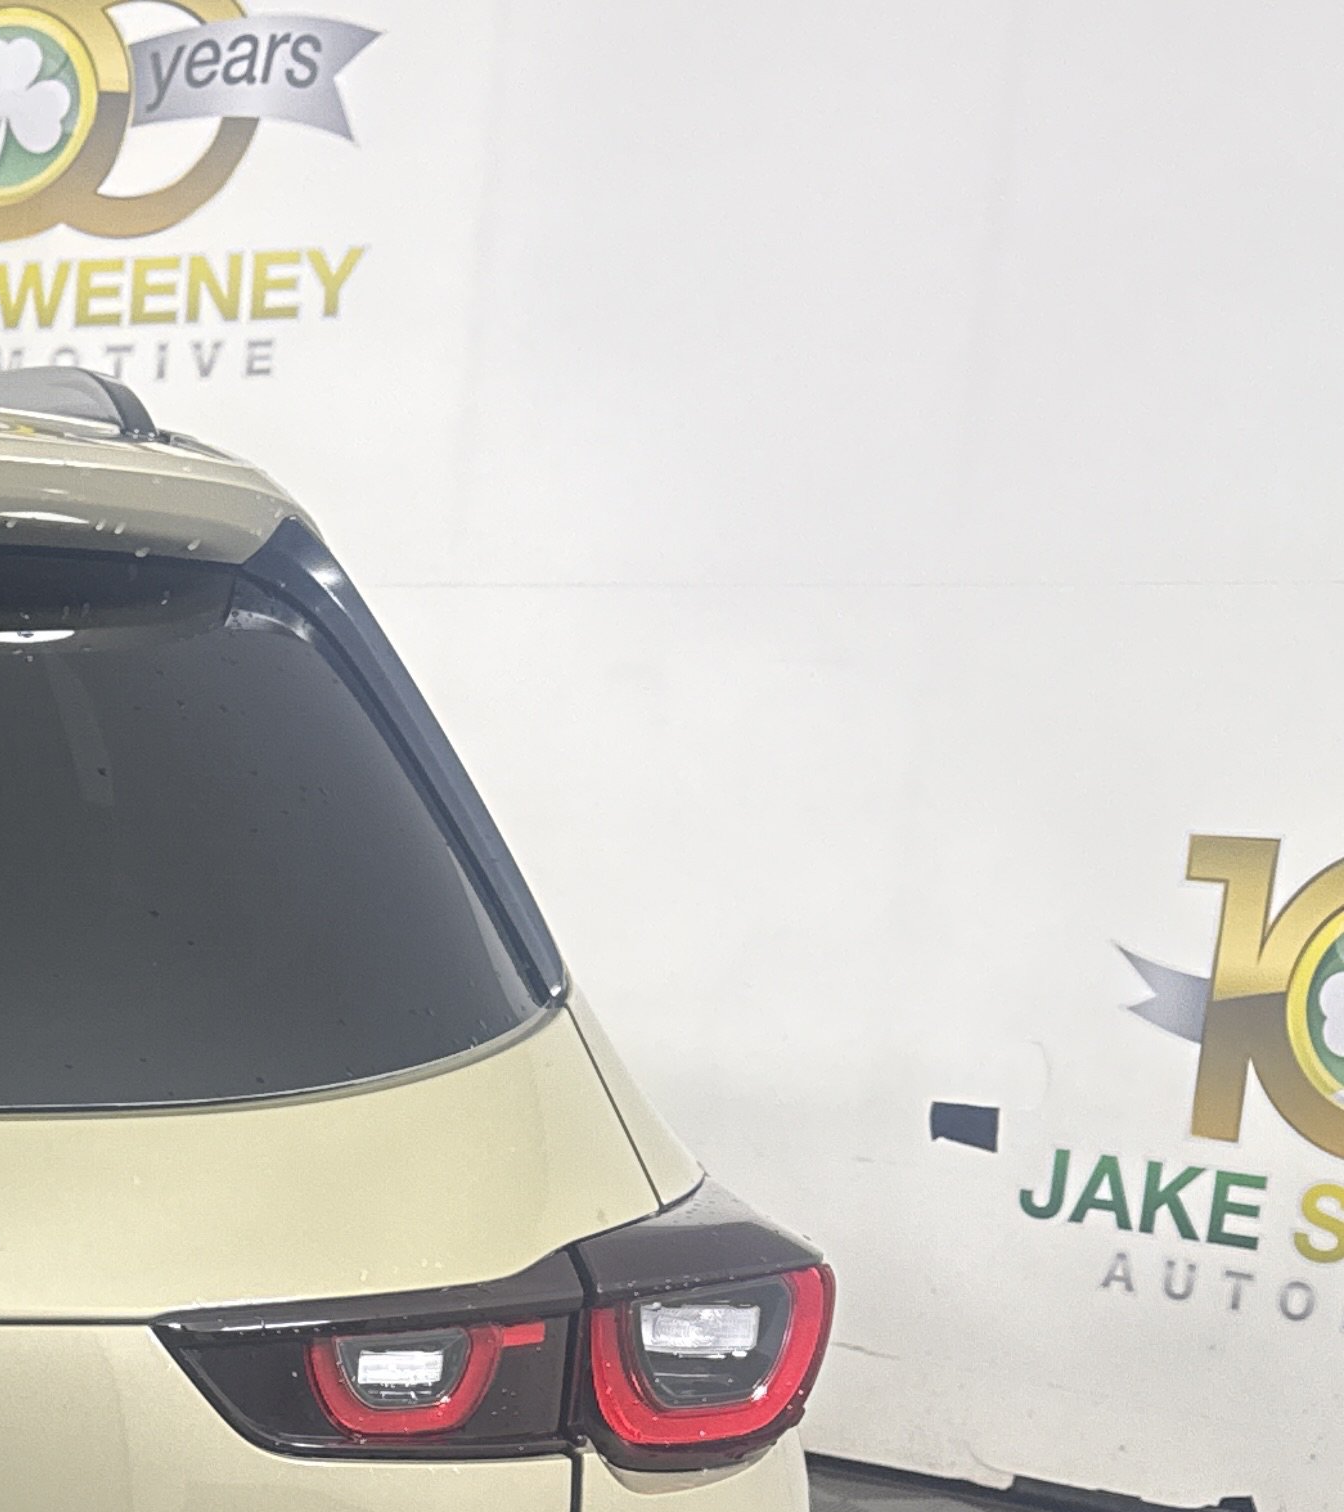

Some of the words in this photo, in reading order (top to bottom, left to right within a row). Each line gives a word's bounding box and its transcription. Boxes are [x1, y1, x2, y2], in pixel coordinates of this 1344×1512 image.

[146, 30, 324, 112] years
[1019, 1148, 1268, 1251] JAKE
[1100, 1253, 1344, 1332] AUTO
